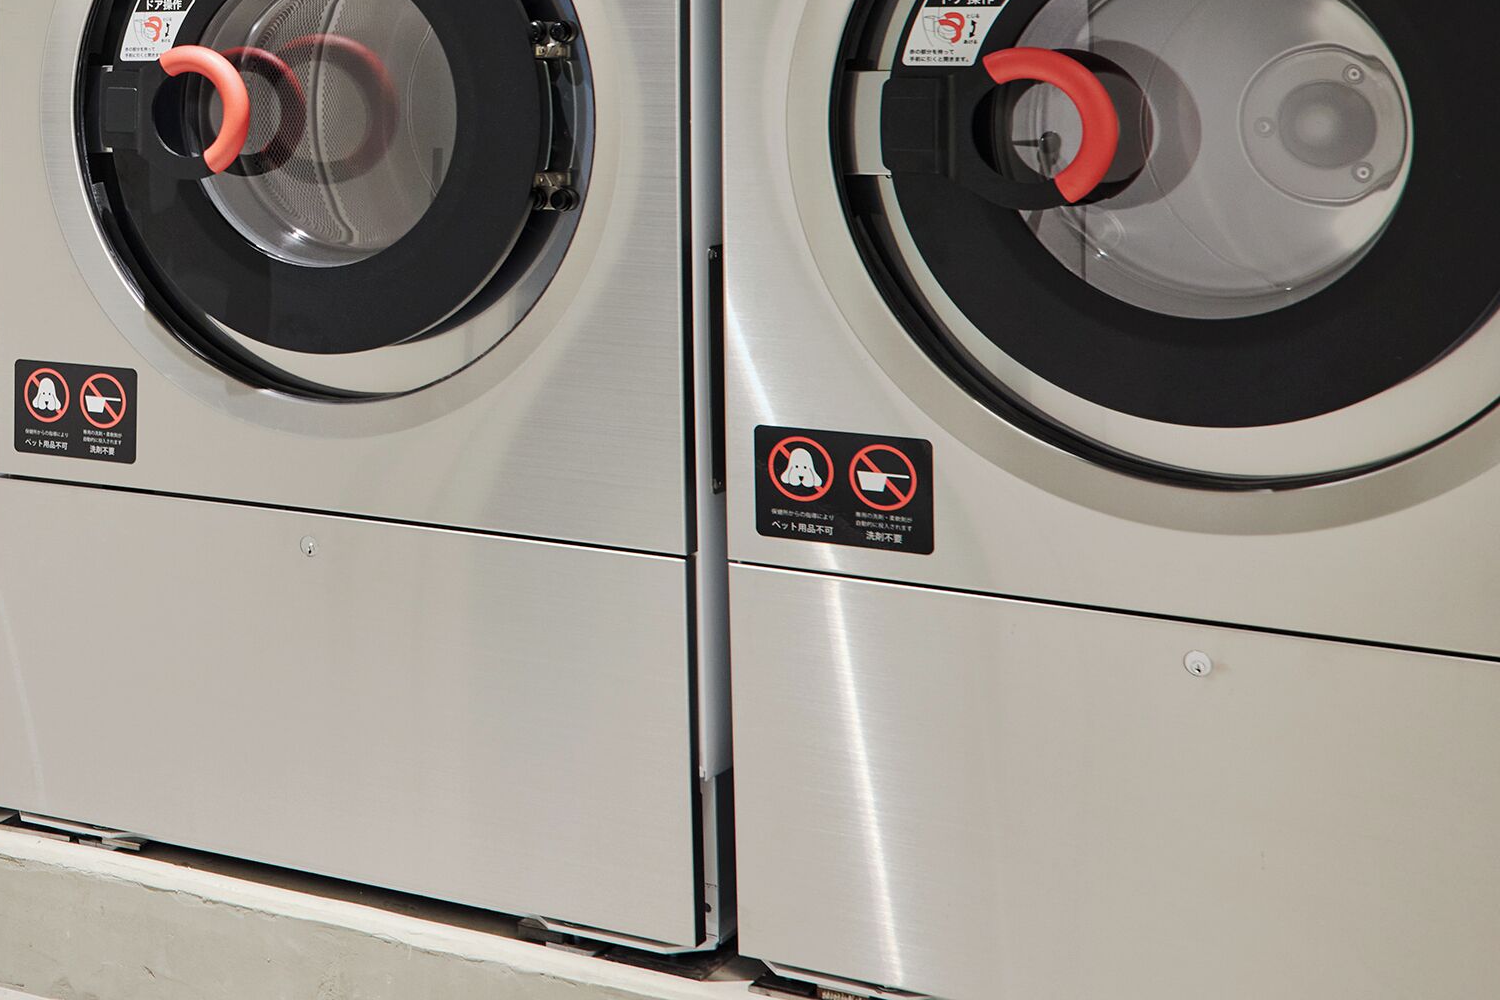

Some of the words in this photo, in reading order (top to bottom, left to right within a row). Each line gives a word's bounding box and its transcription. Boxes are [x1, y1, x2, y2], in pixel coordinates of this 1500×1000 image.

[146, 0, 182, 11] ドア操作
[25, 439, 68, 451] ペット用品不可
[772, 521, 834, 536] ペット用品不可
[866, 530, 903, 543] 洗剤不要
